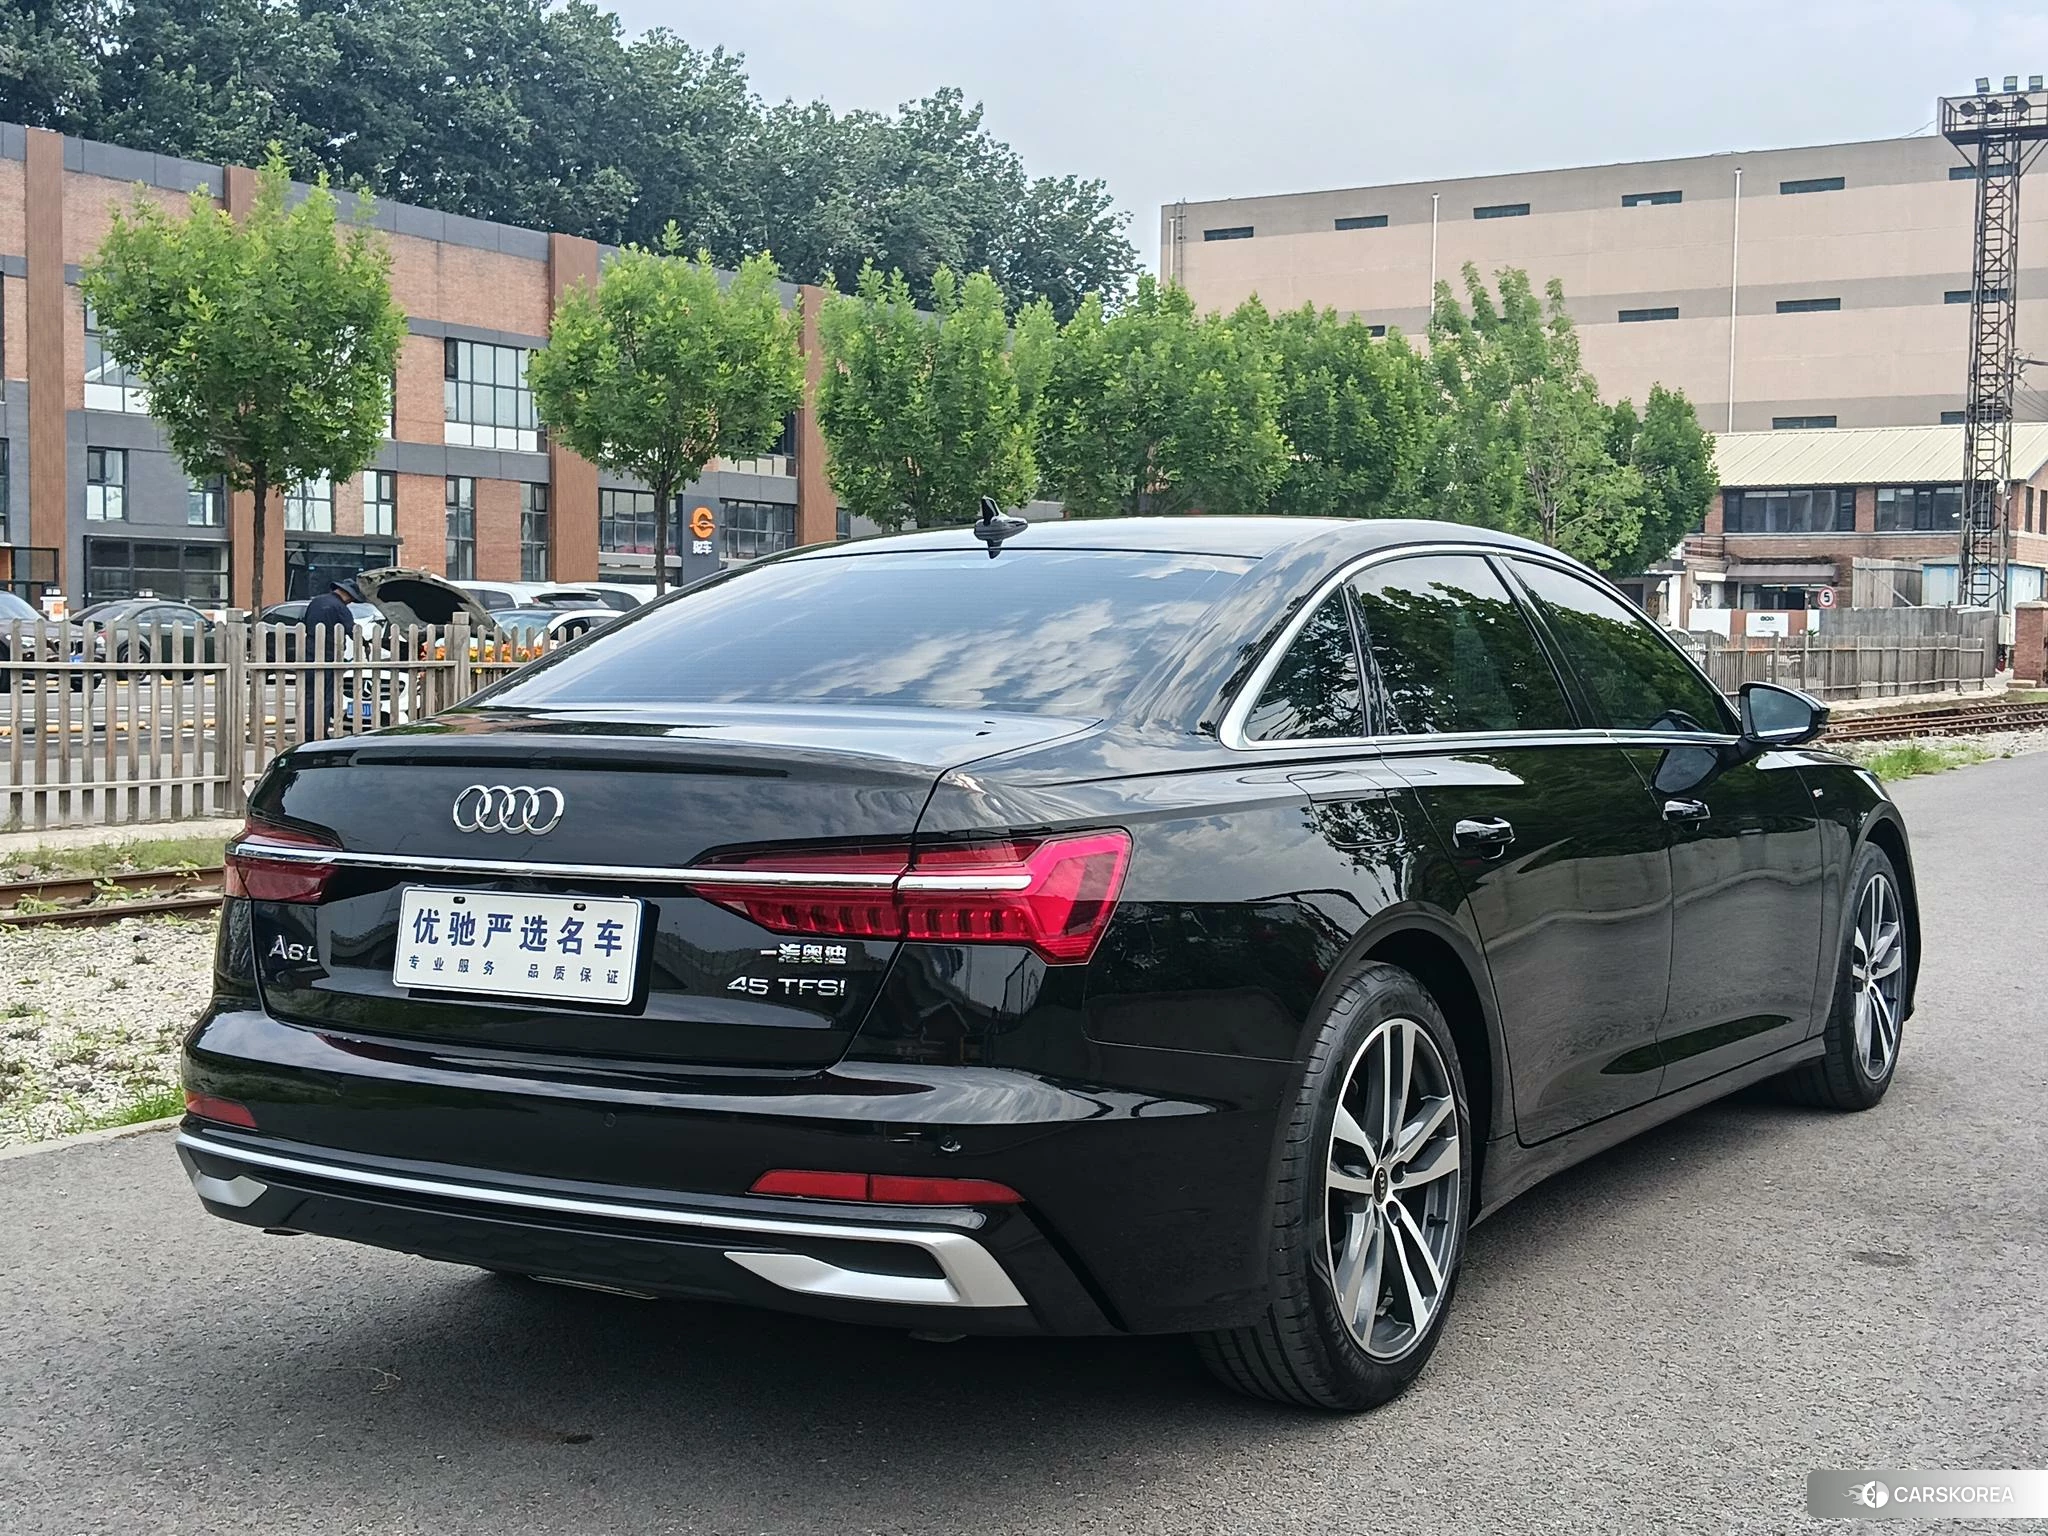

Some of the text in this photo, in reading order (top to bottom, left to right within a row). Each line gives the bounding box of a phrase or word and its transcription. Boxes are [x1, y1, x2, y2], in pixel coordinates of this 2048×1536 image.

[1823, 591, 1832, 603] 5
[412, 908, 624, 958] 优驰严选名车
[268, 934, 318, 963] A6L
[760, 943, 847, 965] 一汽奥迪
[408, 954, 619, 985] 专业服务 品质保证
[726, 976, 846, 996] 45 TFSI
